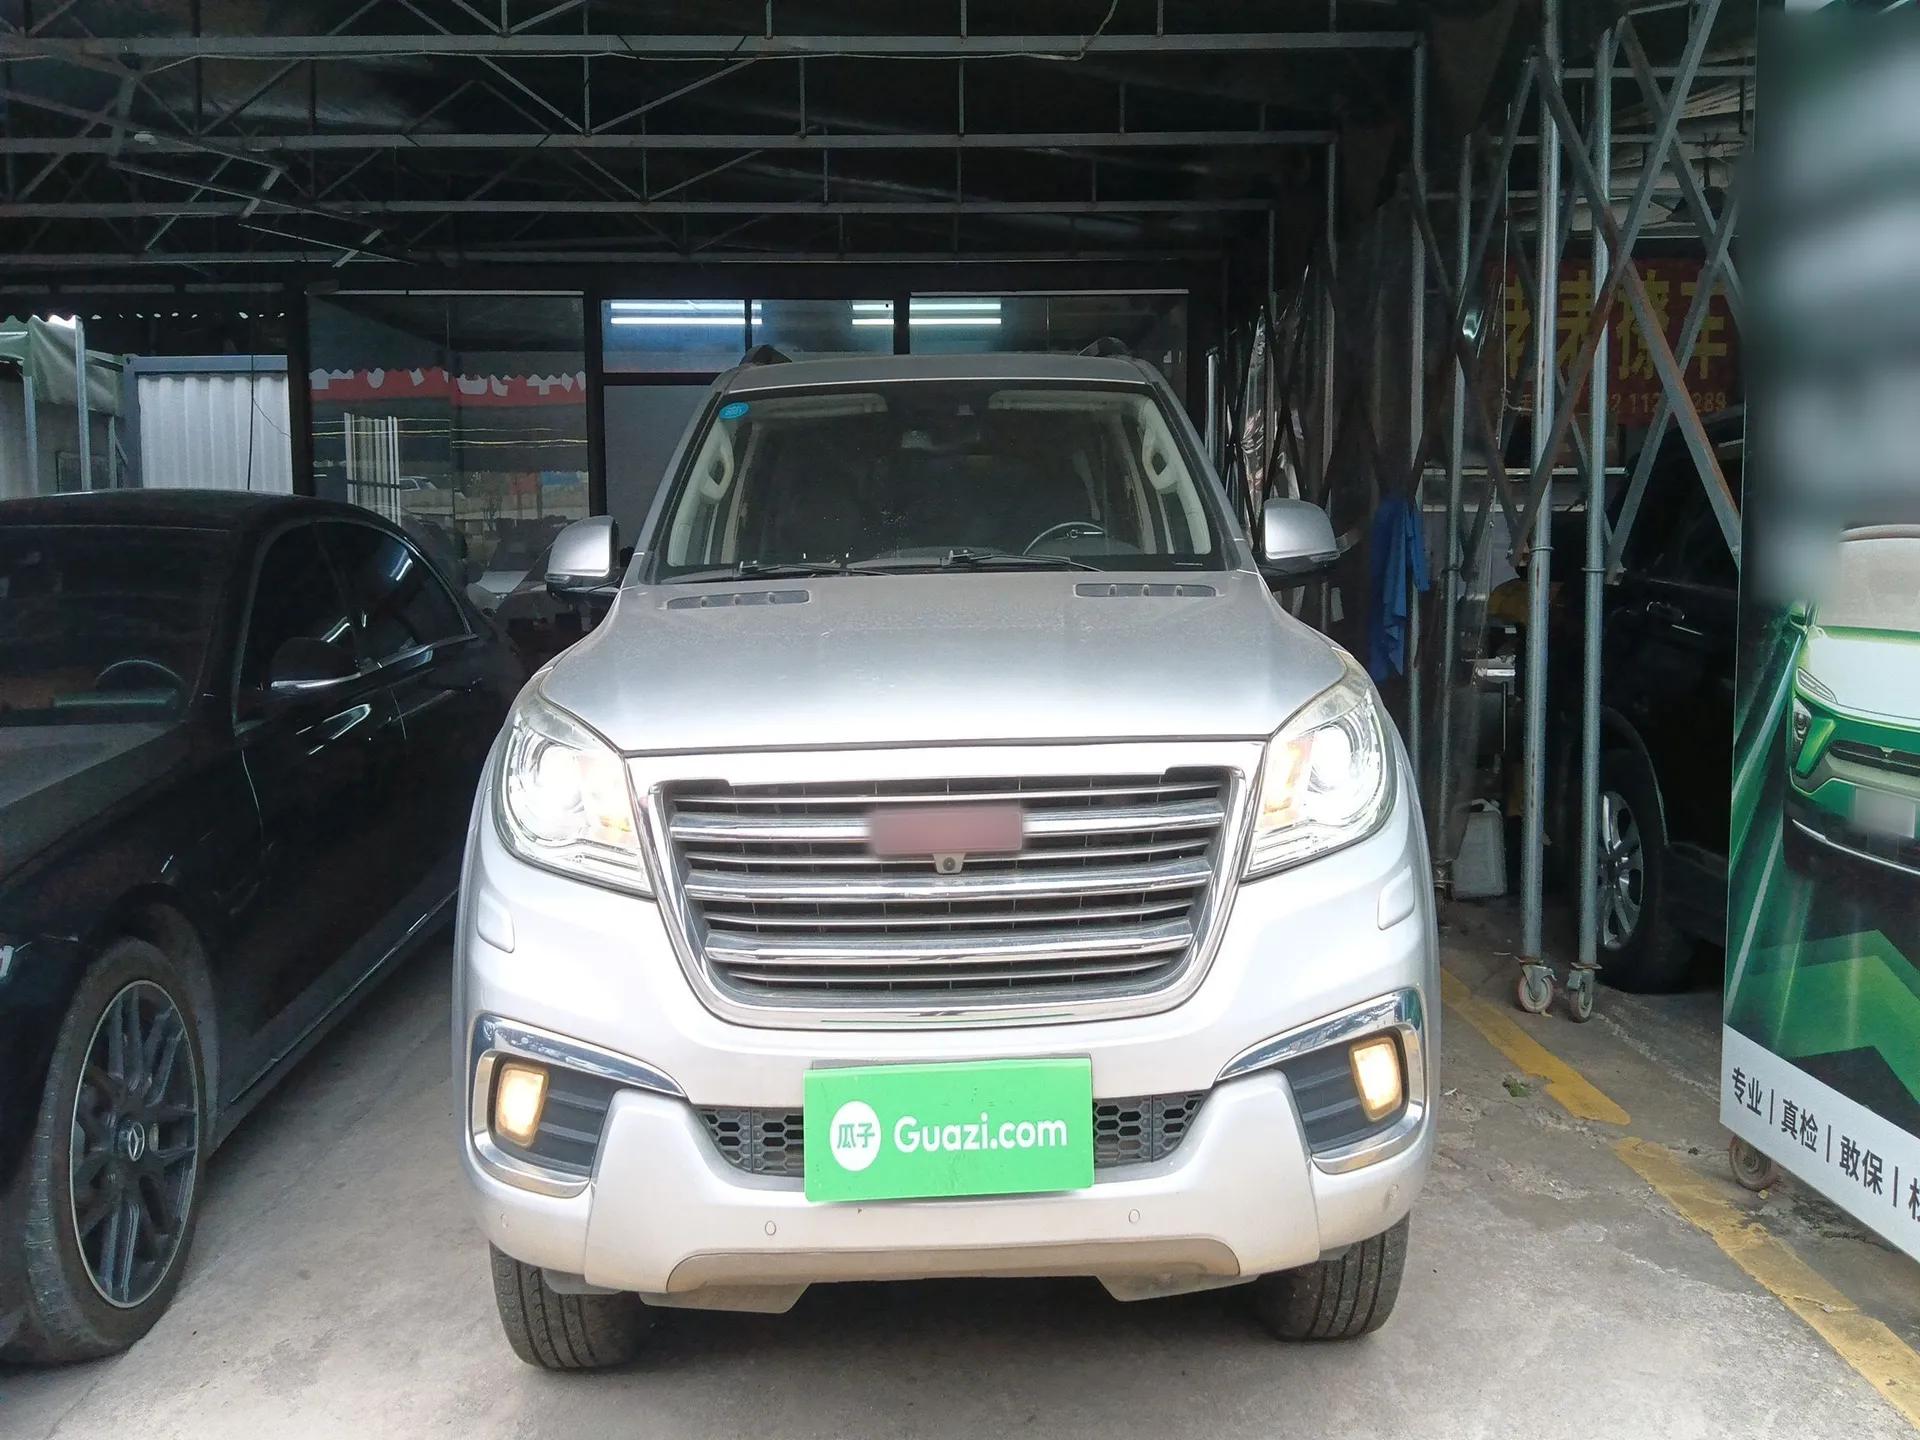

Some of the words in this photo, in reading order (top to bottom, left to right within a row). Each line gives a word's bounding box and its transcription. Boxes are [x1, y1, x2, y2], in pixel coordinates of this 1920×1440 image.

[837, 1122, 876, 1149] 瓜子
[894, 1112, 1068, 1153] Guazi.com
[1732, 1067, 1762, 1116] 专业
[1781, 1098, 1818, 1153] 真检
[1839, 1135, 1883, 1195] 敢保
